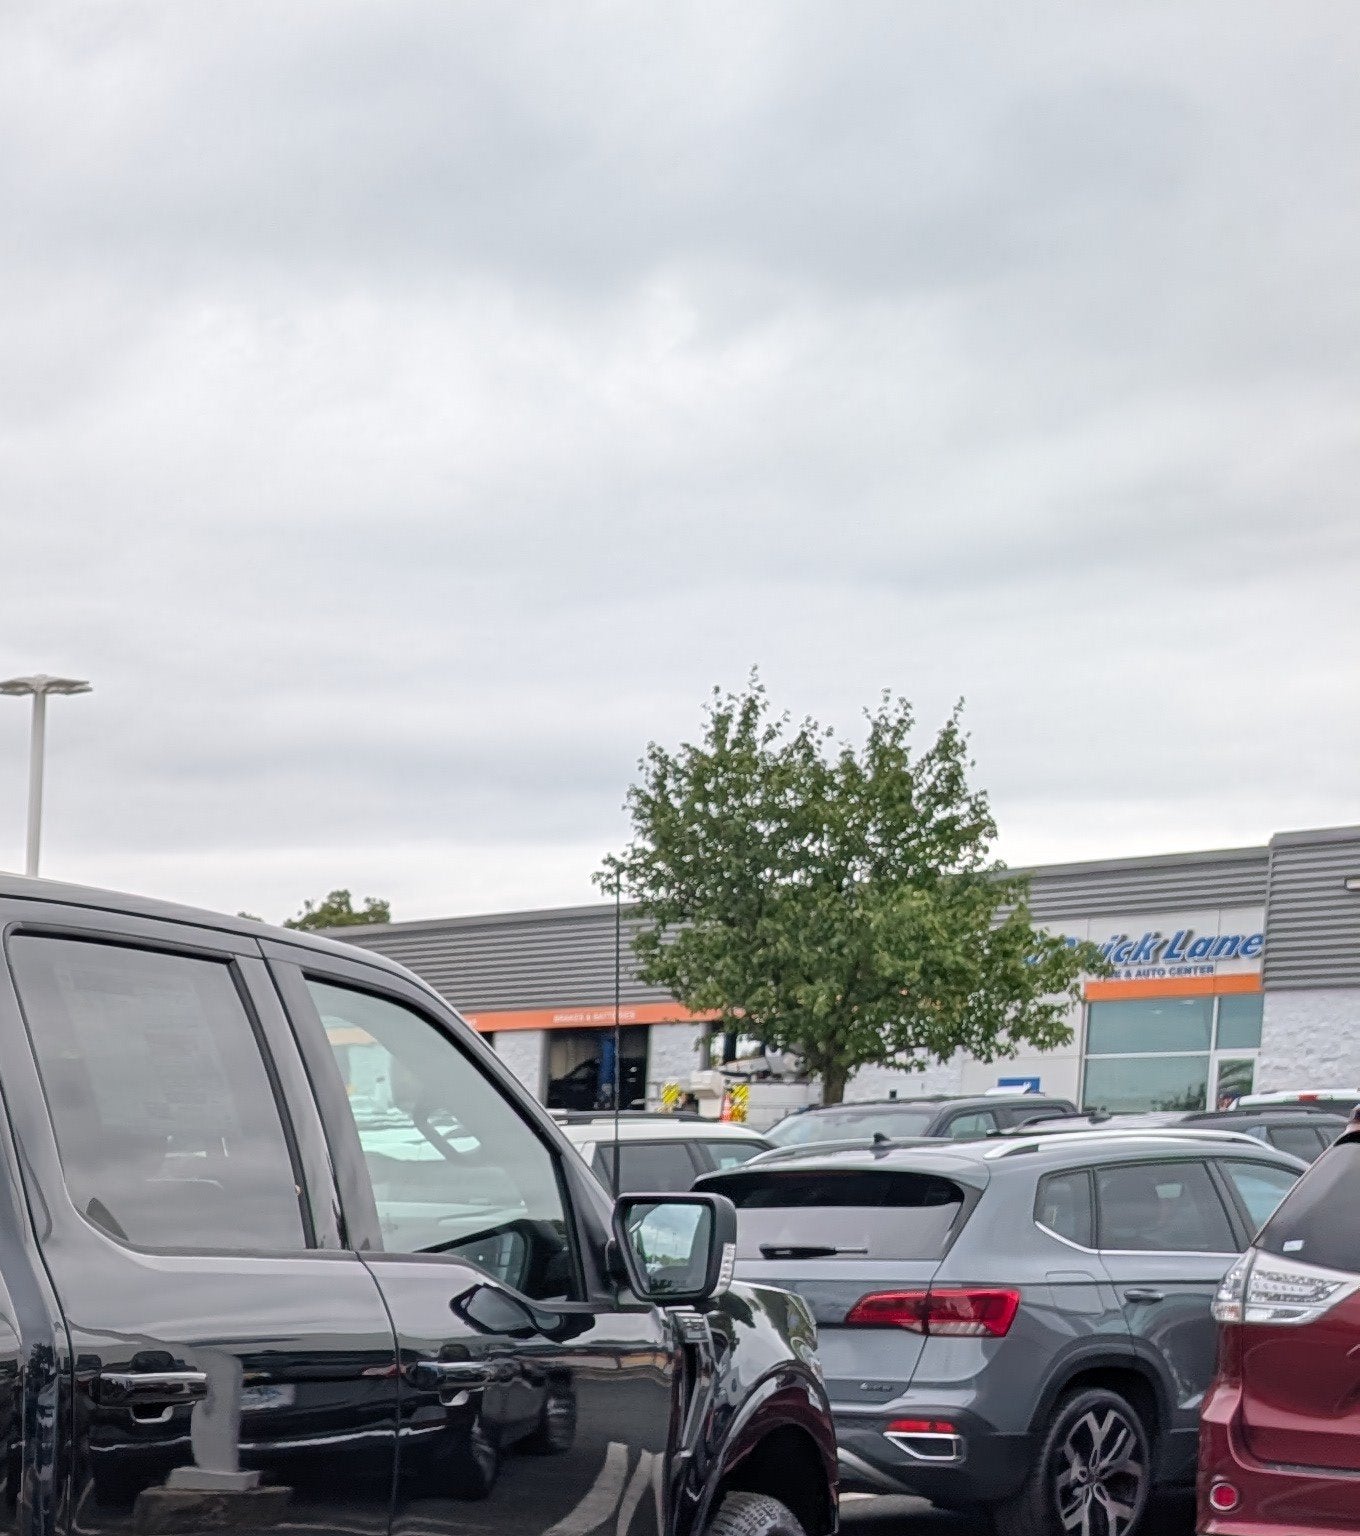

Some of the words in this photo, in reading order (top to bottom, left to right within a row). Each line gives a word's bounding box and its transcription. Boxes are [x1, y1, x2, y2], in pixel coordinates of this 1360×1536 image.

[1163, 930, 1265, 961] Lane
[1135, 967, 1166, 978] AUTO
[1169, 964, 1215, 976] CENTER
